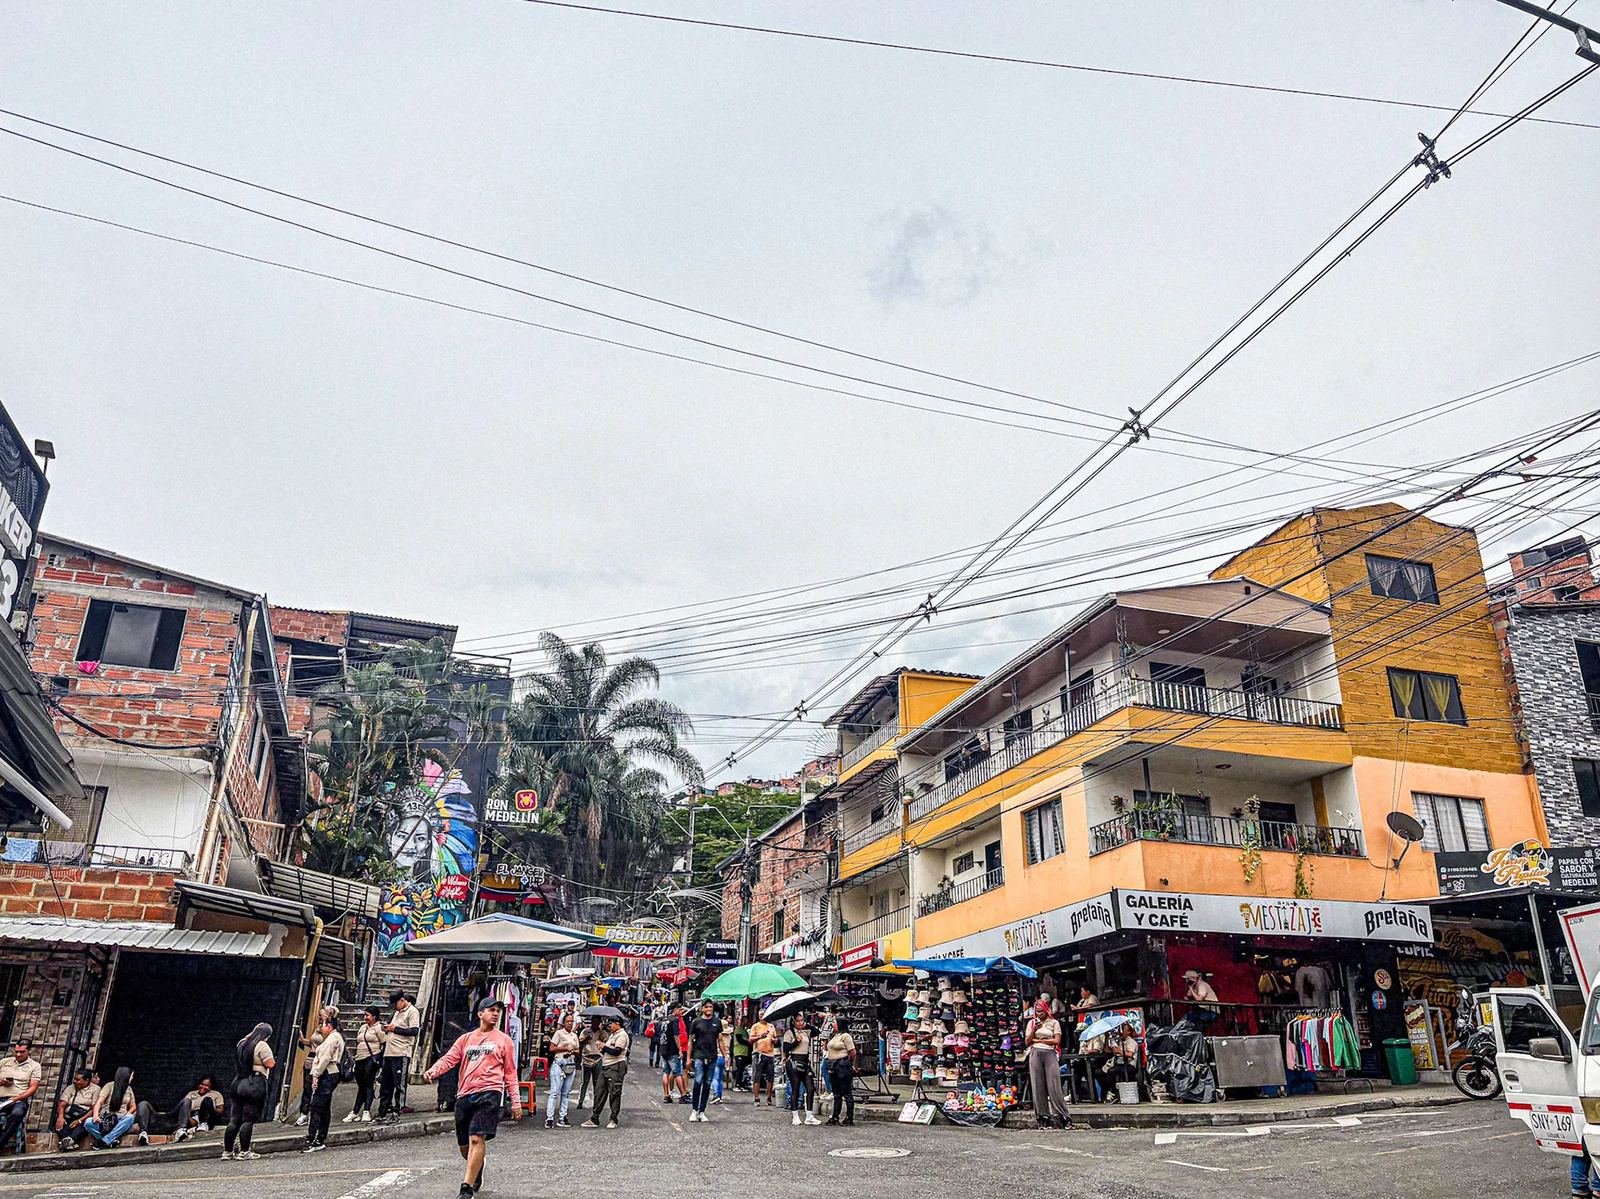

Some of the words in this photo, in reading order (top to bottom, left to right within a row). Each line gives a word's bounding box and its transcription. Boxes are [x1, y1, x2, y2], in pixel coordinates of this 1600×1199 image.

[486, 798, 508, 810] RON
[1482, 849, 1527, 871] Juan
[1579, 857, 1594, 865] CON
[1559, 865, 1588, 874] SABOR
[1588, 864, 1594, 872] Y
[1561, 878, 1598, 886] MEDELLIN
[1125, 895, 1194, 911] GALERÍA
[1070, 901, 1114, 938] Bretaña
[1134, 913, 1145, 925] Y
[1148, 912, 1190, 928] CAFÉ
[1363, 906, 1429, 939] Bretaña
[1531, 1113, 1550, 1130] SNY
[1554, 1115, 1572, 1132] 169
